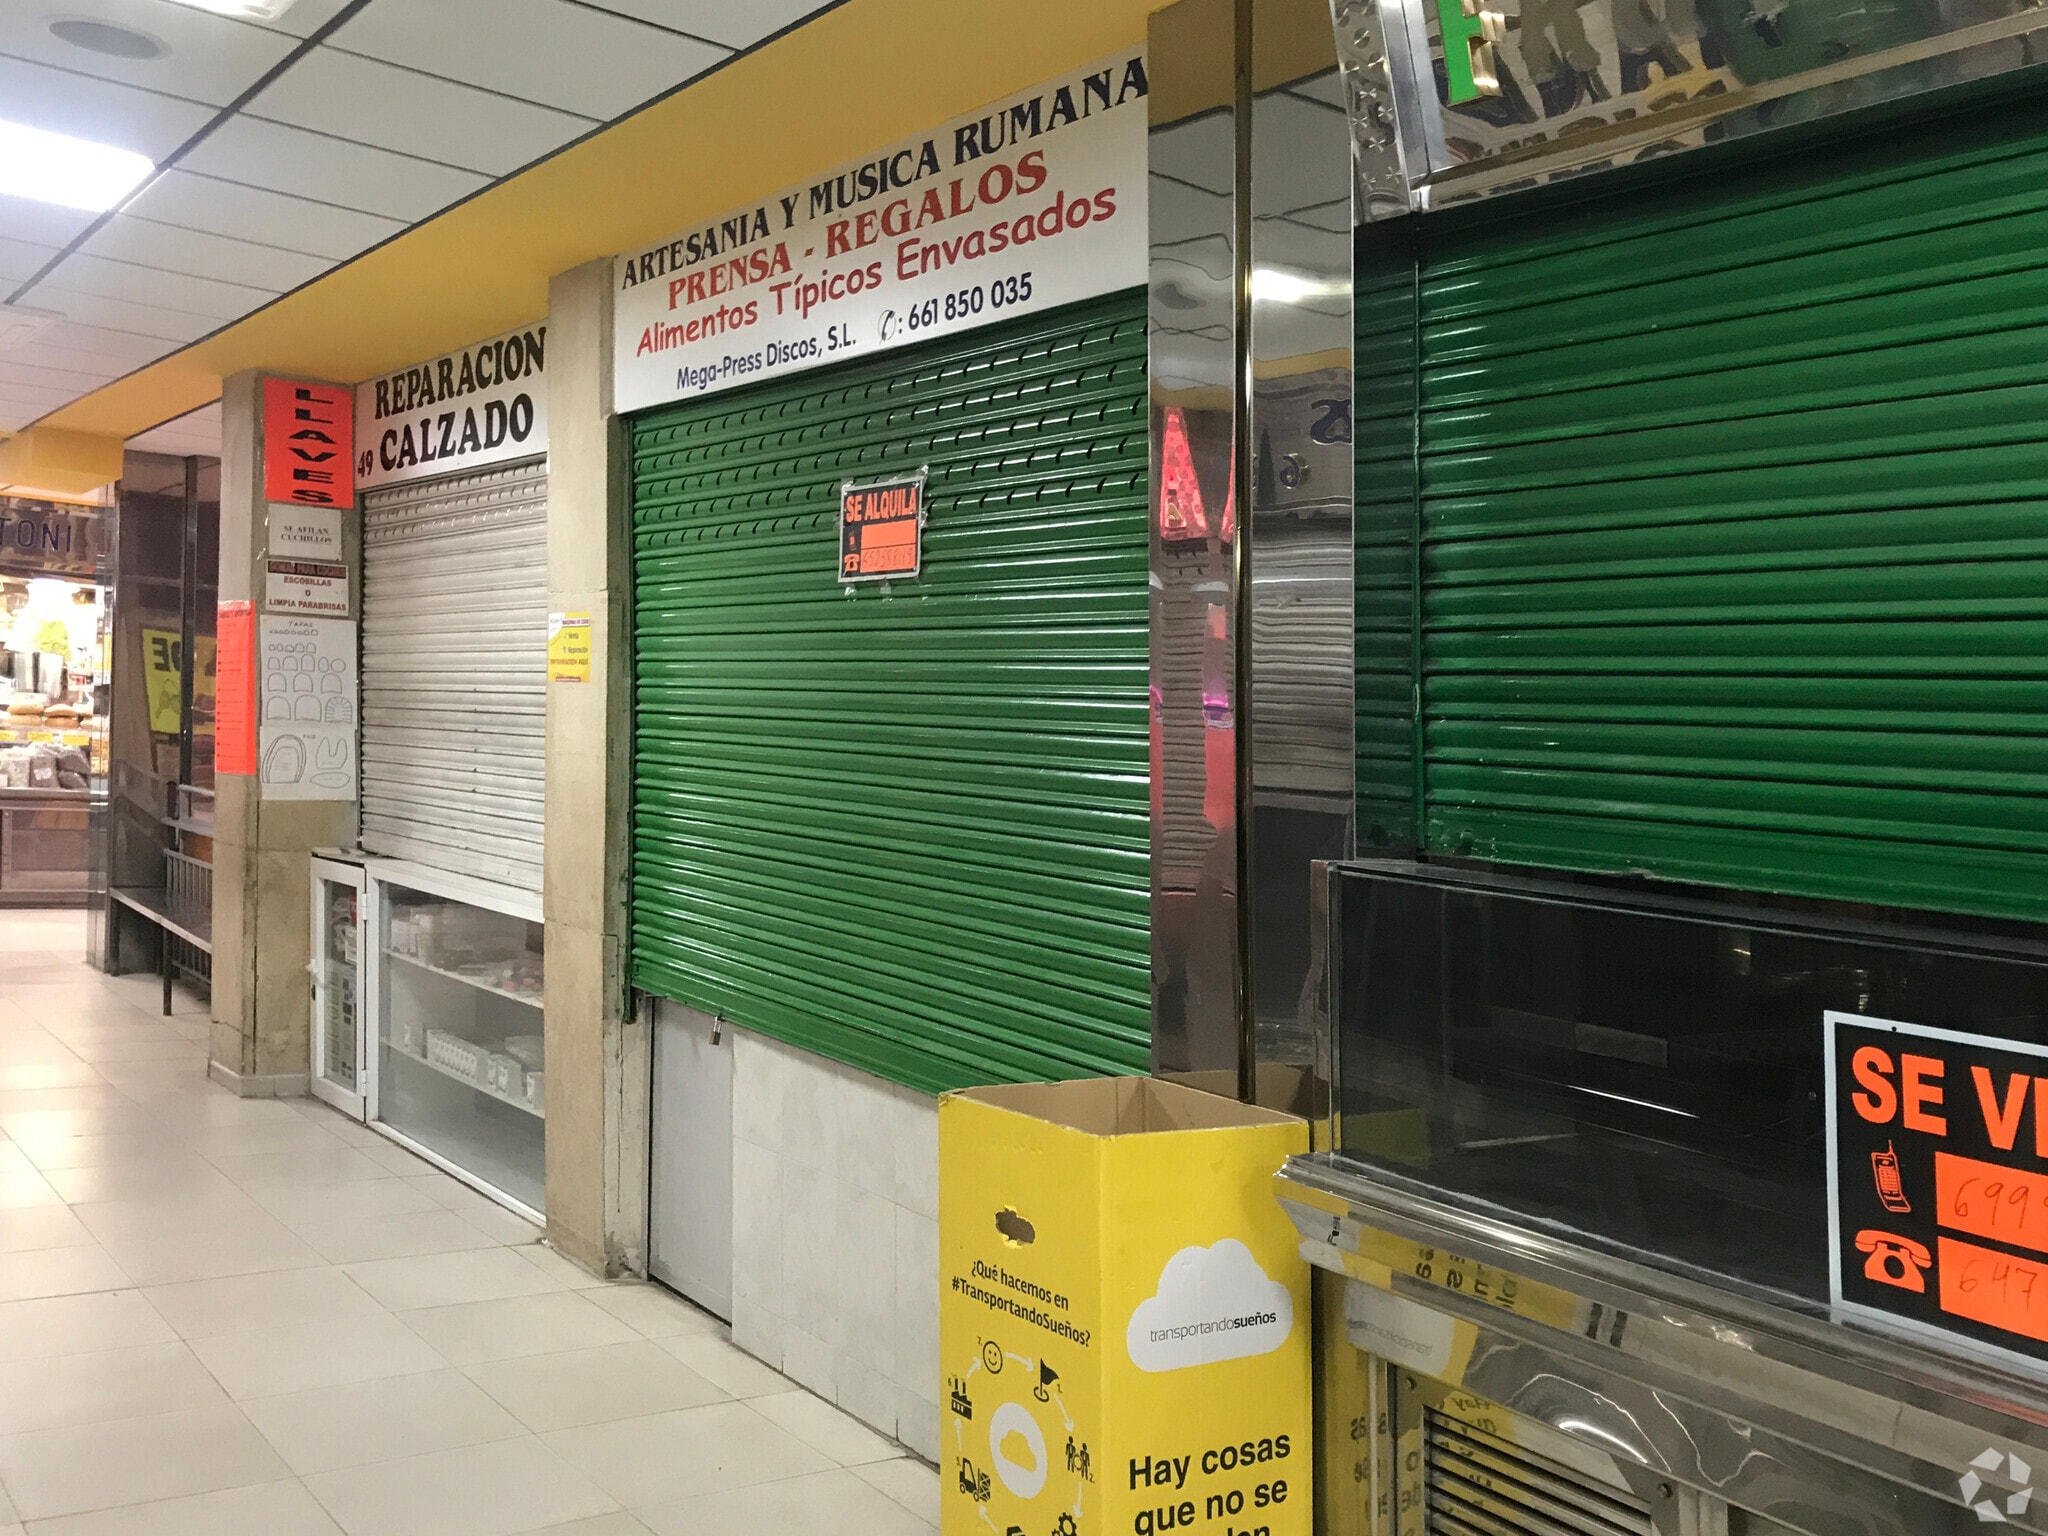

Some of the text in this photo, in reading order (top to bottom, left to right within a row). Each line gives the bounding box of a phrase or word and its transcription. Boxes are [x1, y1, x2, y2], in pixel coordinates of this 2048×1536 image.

[621, 56, 1149, 290] ARTESANIA Y MUSICA RUMANA
[668, 241, 793, 311] PRENSA
[825, 149, 1048, 260] REGALOS
[636, 187, 1117, 357] Alimentos Típicos Envasados
[676, 271, 1032, 391] Mega-Press Discos, S.L. 661 850 035
[374, 326, 547, 420] REPARACION
[288, 387, 338, 503] LLAVES
[357, 392, 534, 478] 49 CALZADO
[845, 487, 917, 523] SE ALQUILA
[269, 598, 347, 611] LIMPIA PARABRISAS
[283, 575, 332, 587] ESCOBILLAS
[1852, 1045, 2048, 1159] SE V
[1954, 1177, 2048, 1230] 699
[952, 1276, 1091, 1347] #TransportandoSueños?
[971, 1259, 1069, 1311] ¿Qué hacemos en
[1150, 1311, 1277, 1343] transportandosueños
[1129, 1434, 1291, 1490] Hay cosas
[1134, 1479, 1288, 1536] que no se
